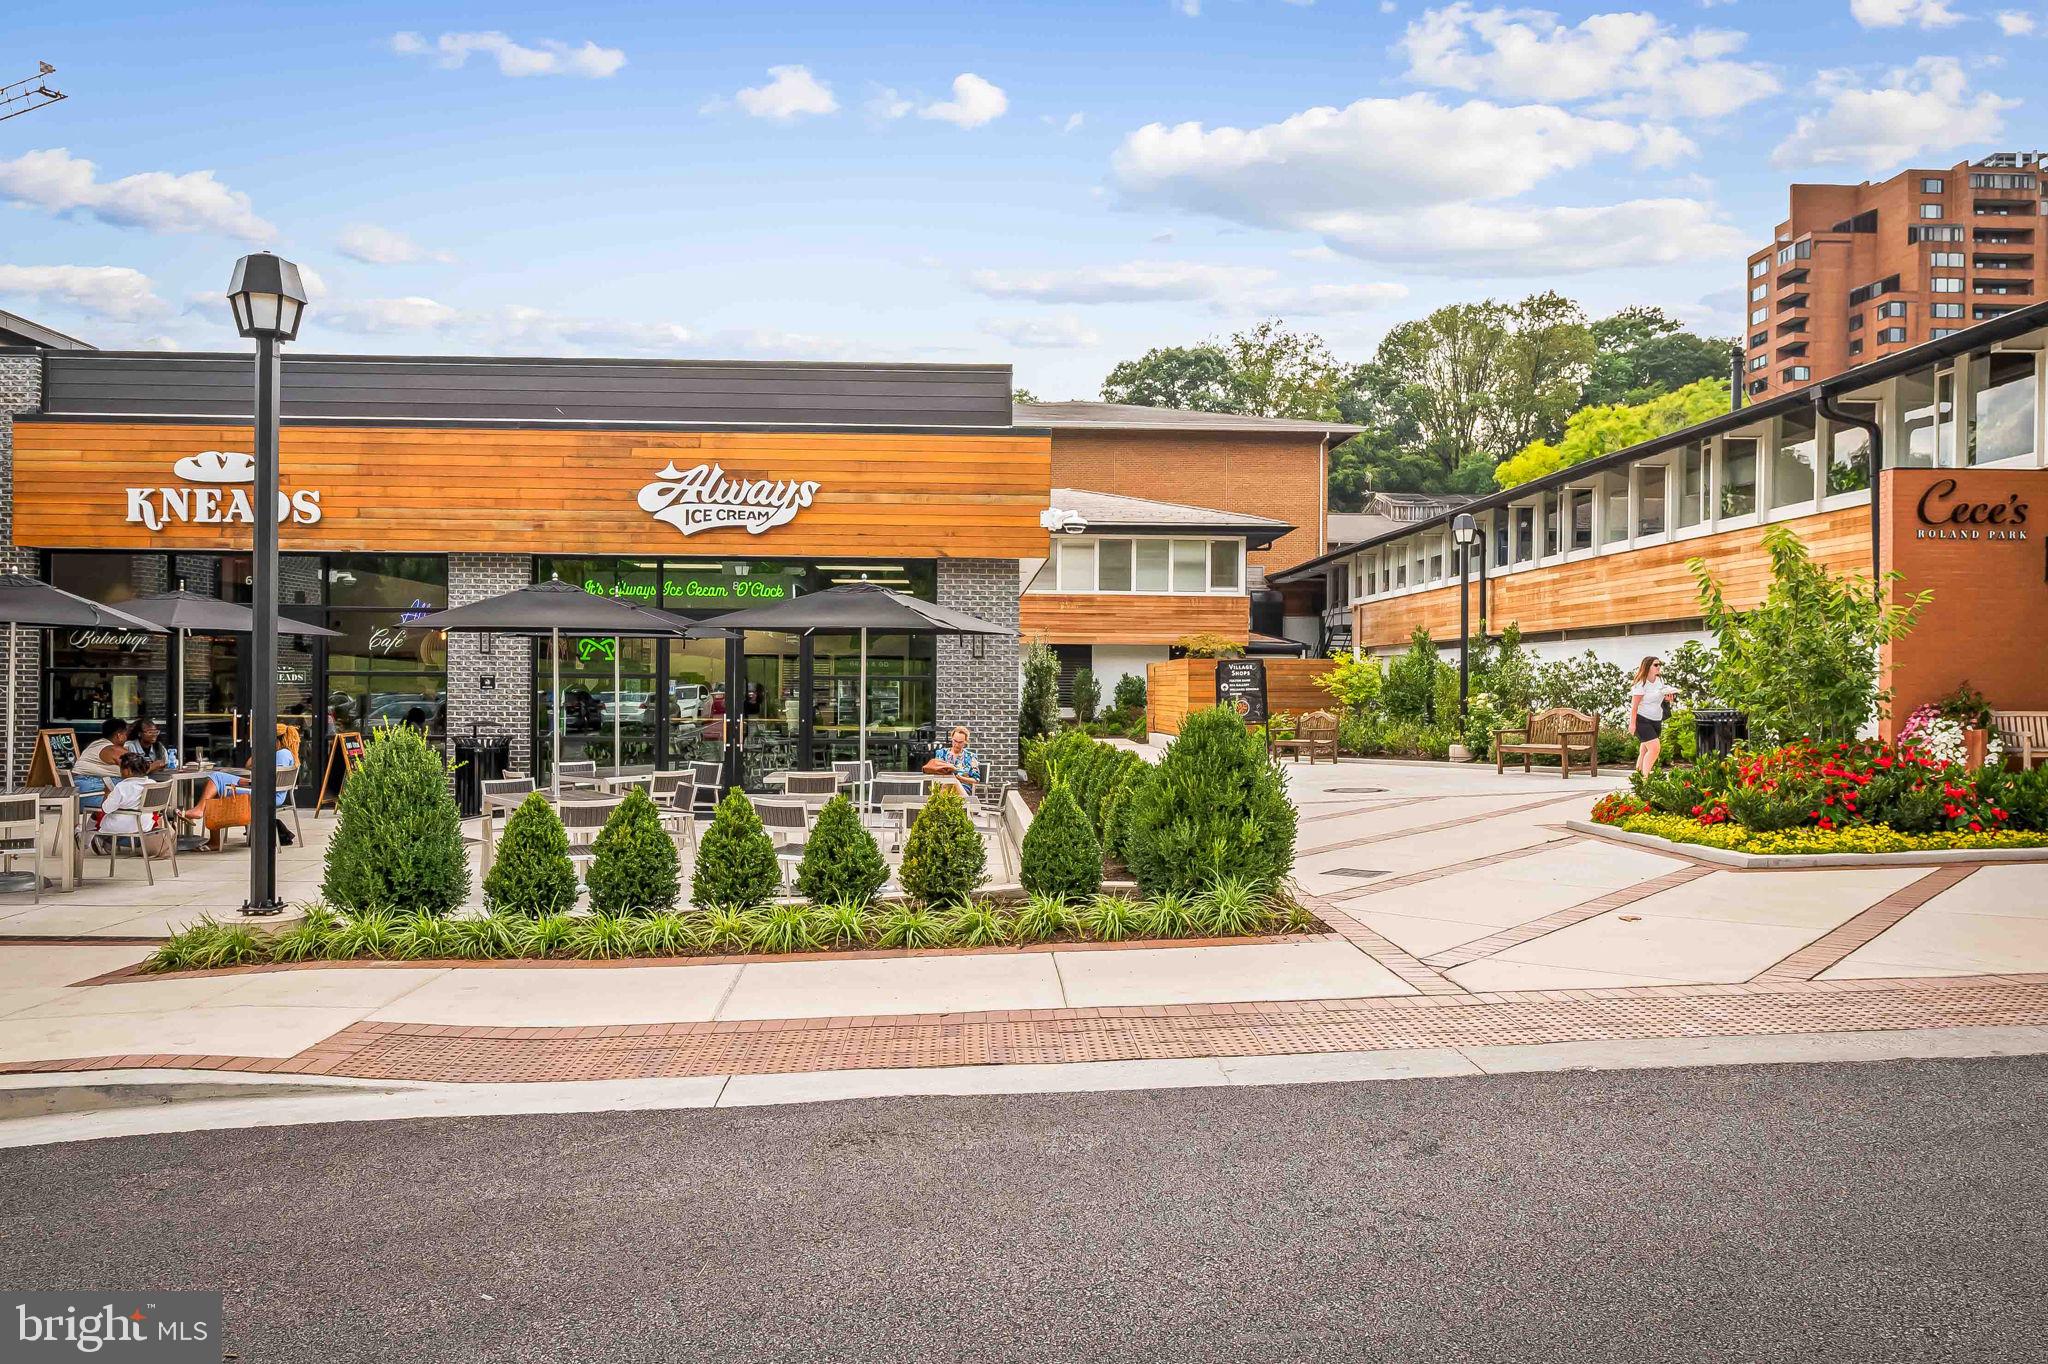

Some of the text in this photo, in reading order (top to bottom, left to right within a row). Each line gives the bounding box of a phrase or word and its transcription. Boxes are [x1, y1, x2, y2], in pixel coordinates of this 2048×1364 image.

[637, 460, 821, 527] Always
[1917, 479, 2028, 525] Cece's
[685, 508, 770, 526] ICE CREAM
[1917, 529, 2028, 539] ROLAND PARK
[245, 575, 253, 585] 6
[585, 580, 604, 596] It's
[662, 580, 683, 596] Ice
[686, 581, 728, 597] Cream
[736, 581, 784, 598] O'Clock
[69, 629, 149, 653] Bakeshop
[369, 628, 407, 655] Café
